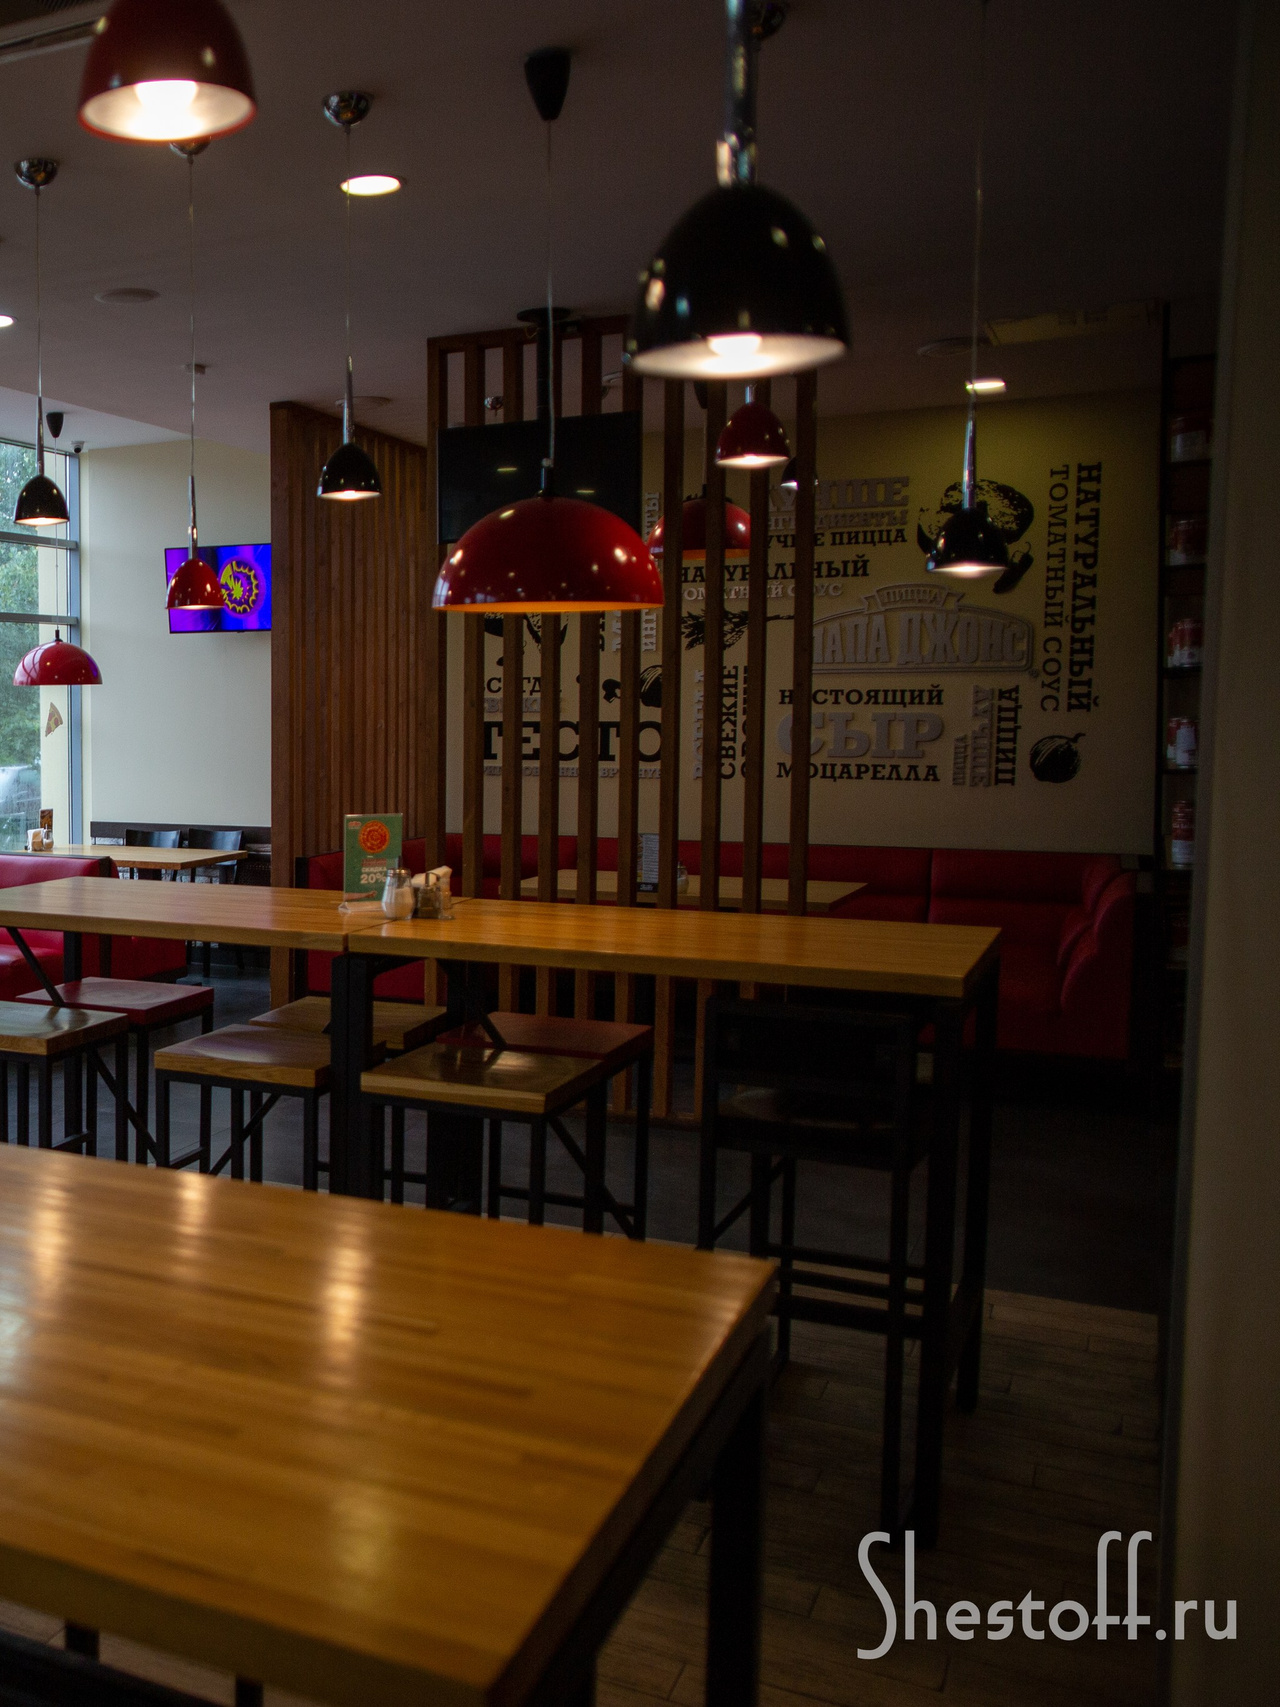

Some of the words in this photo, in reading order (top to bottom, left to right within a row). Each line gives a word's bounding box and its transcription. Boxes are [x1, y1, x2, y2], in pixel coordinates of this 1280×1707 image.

[830, 528, 908, 547] ПИЦЦА
[1044, 464, 1070, 628] ТОМАТНЫЙ
[880, 588, 943, 604] ПИЦЦА
[1067, 461, 1103, 713] НАТУРАЛЬНЫЙ
[897, 611, 1025, 666] ДЖОНС
[778, 684, 945, 708] НСТОЯЩИЙ
[1040, 636, 1063, 712] СОУС
[720, 665, 739, 780] СВЕЖИЕ
[776, 711, 943, 758] СЫР
[995, 684, 1022, 787] ПИЦЦА
